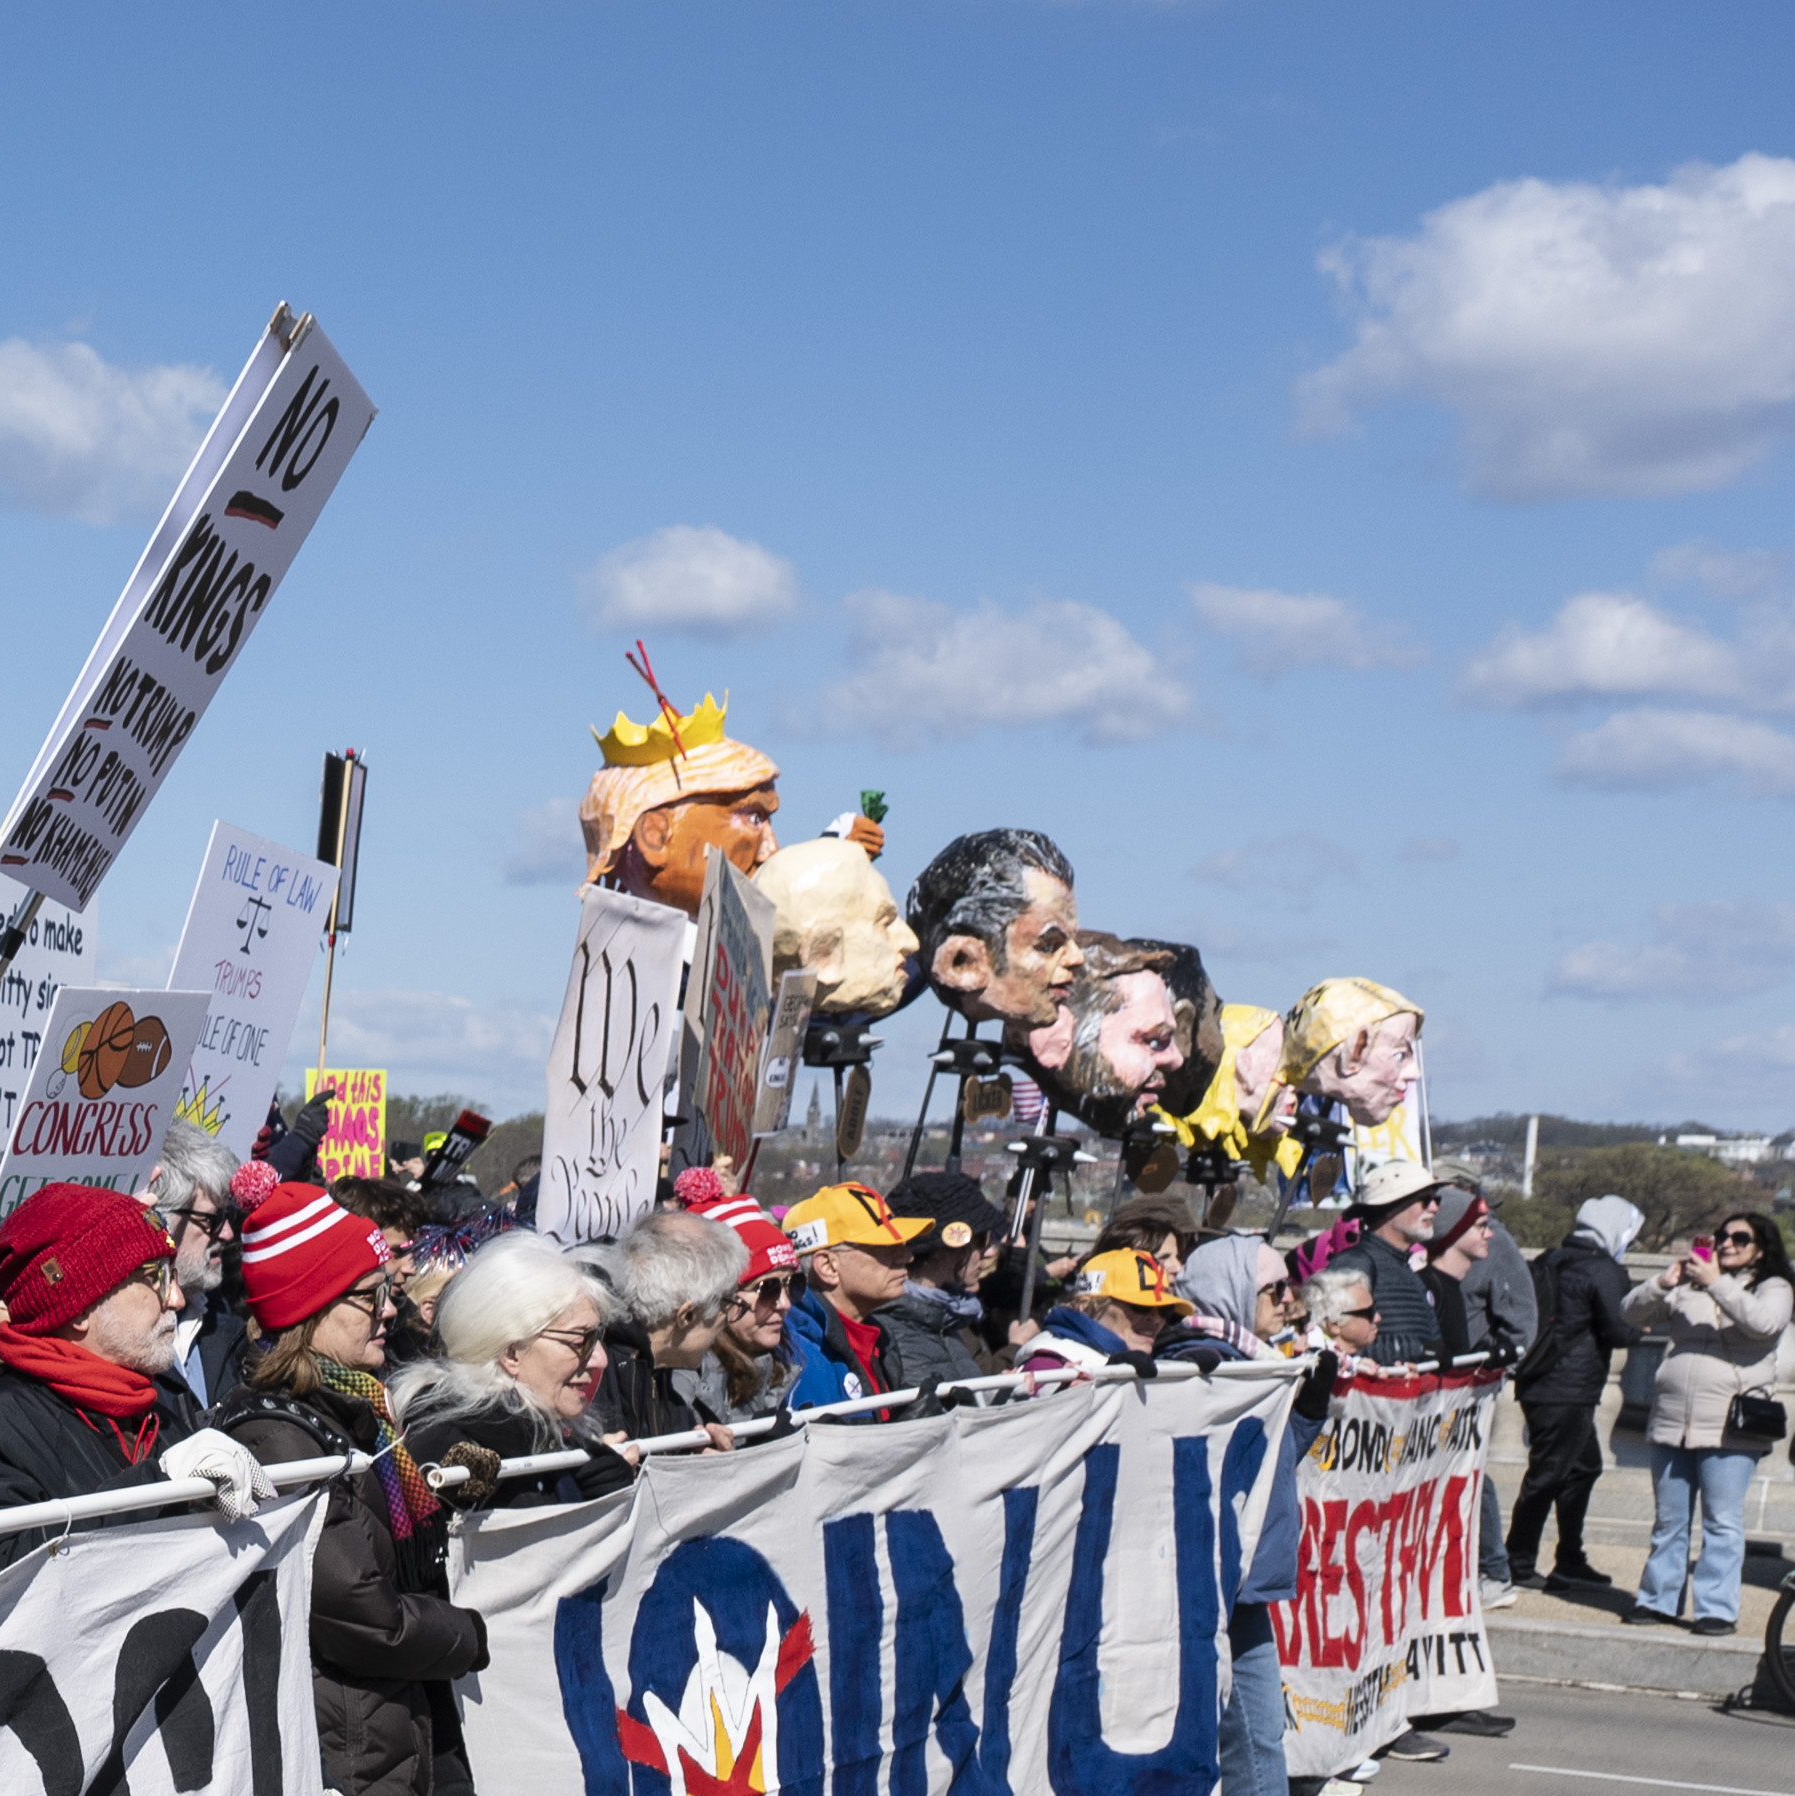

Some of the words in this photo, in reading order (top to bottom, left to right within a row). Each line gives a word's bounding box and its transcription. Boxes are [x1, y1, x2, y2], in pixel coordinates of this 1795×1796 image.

[254, 364, 341, 493] NO
[143, 511, 273, 676] KINGS
[93, 655, 140, 716] NO
[122, 672, 197, 778] TRUMP
[50, 729, 102, 788] NO
[82, 750, 147, 838] PUTIN
[8, 795, 54, 852] NO
[221, 844, 267, 892] RULE
[267, 863, 290, 894] OF
[286, 868, 323, 914] LAW
[43, 911, 83, 957] make
[214, 958, 263, 1000] TRUMPS
[220, 1017, 242, 1055] OF
[236, 1023, 269, 1067] ONE
[11, 1100, 159, 1157] CONGRESS
[318, 1105, 385, 1158] HAOS,
